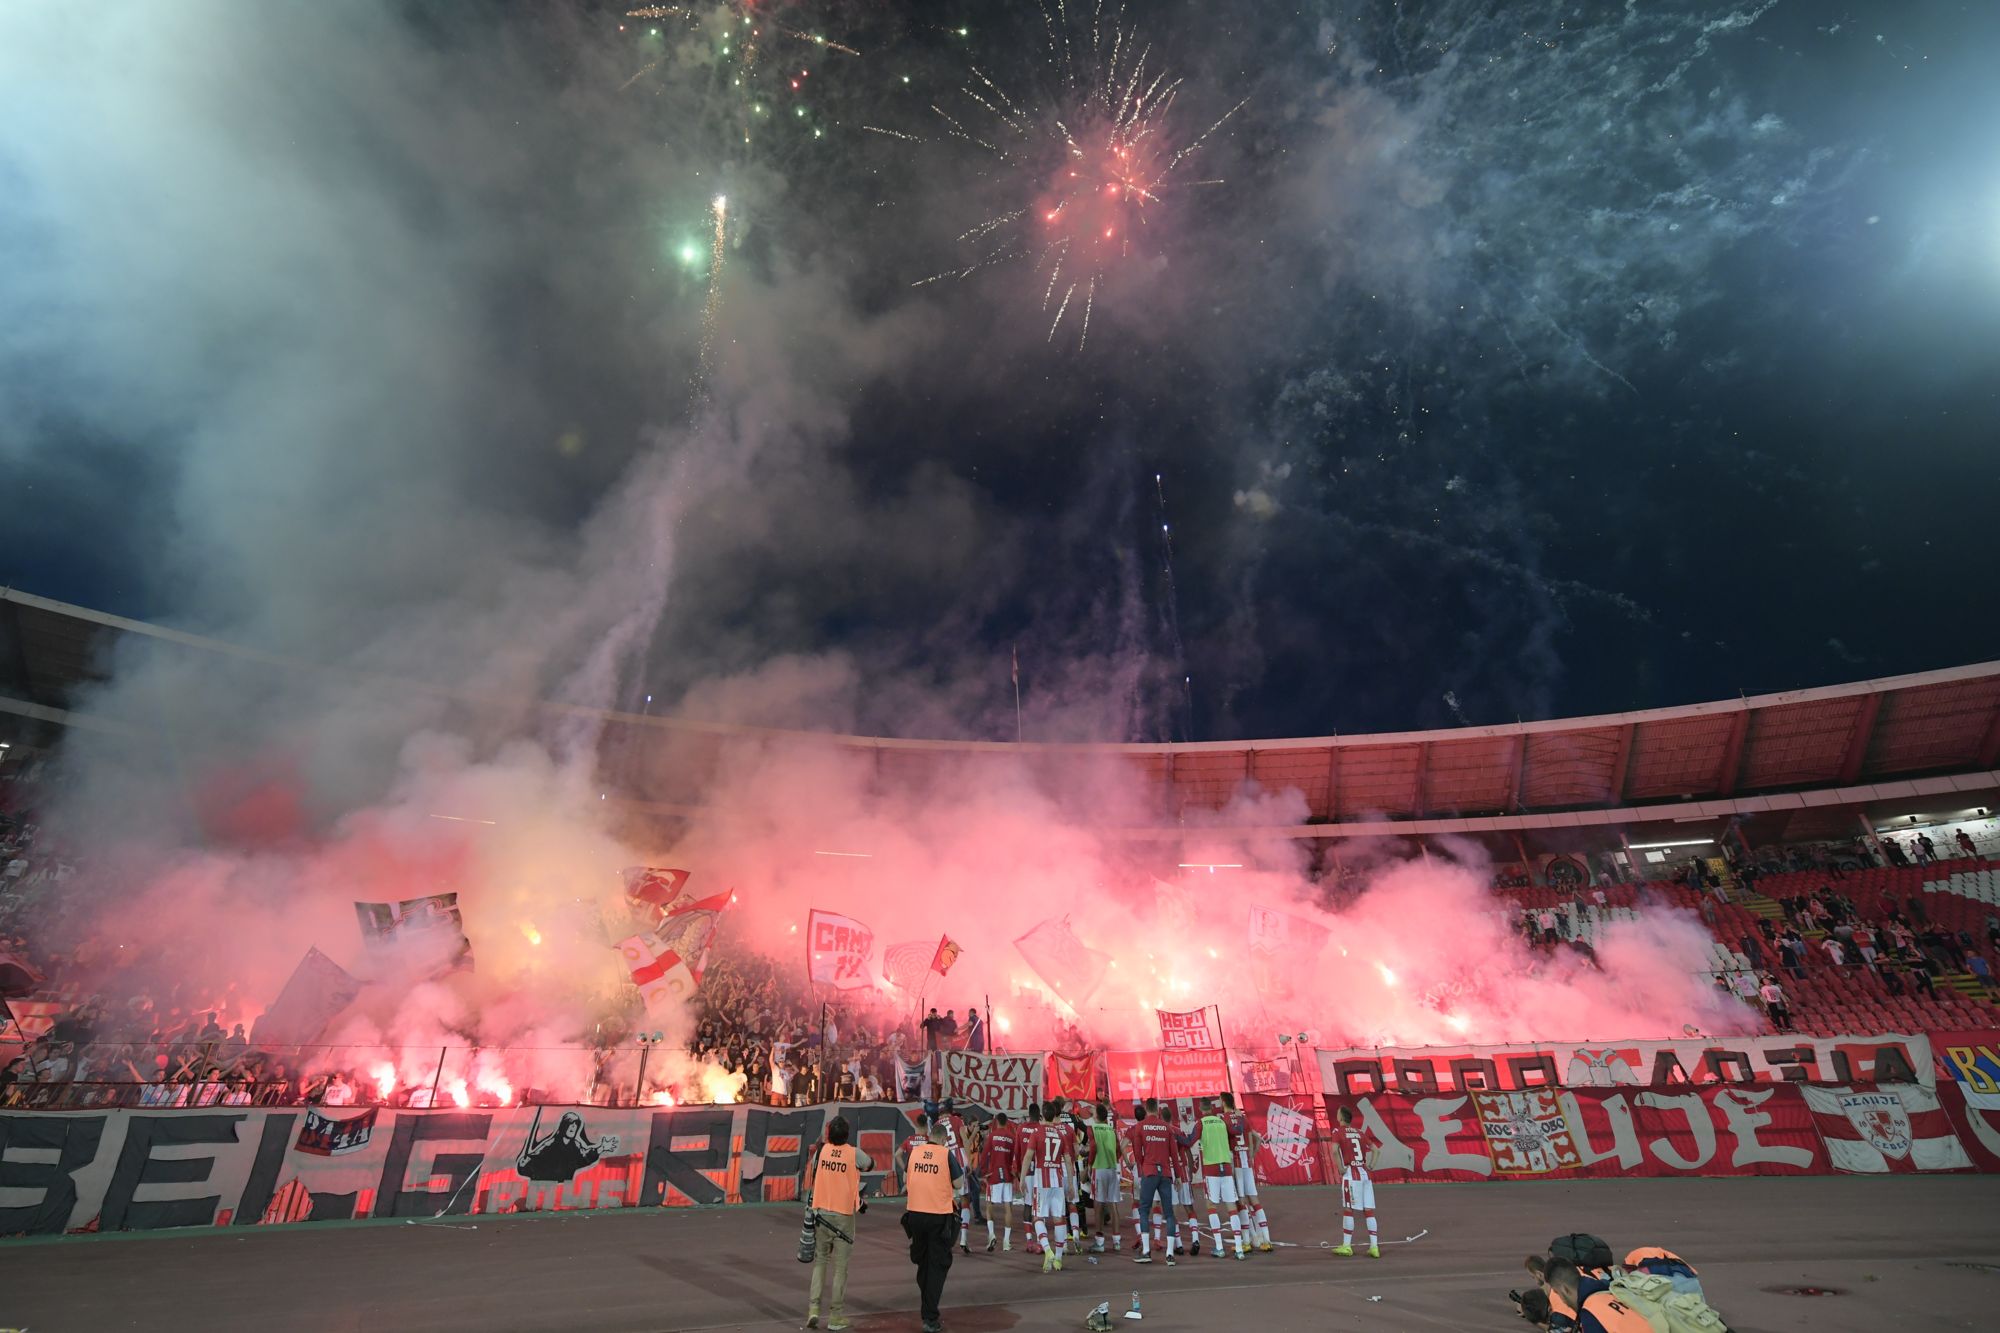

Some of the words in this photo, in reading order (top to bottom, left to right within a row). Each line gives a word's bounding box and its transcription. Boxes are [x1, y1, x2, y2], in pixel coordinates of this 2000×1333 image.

[946, 1051, 1039, 1083] CRAZY
[948, 1074, 1039, 1110] NORTH
[830, 1149, 842, 1158] 282
[1044, 1137, 1061, 1162] 17
[1351, 1139, 1363, 1160] 3
[821, 1159, 847, 1173] PHOTO
[914, 1162, 939, 1174] PHOTO
